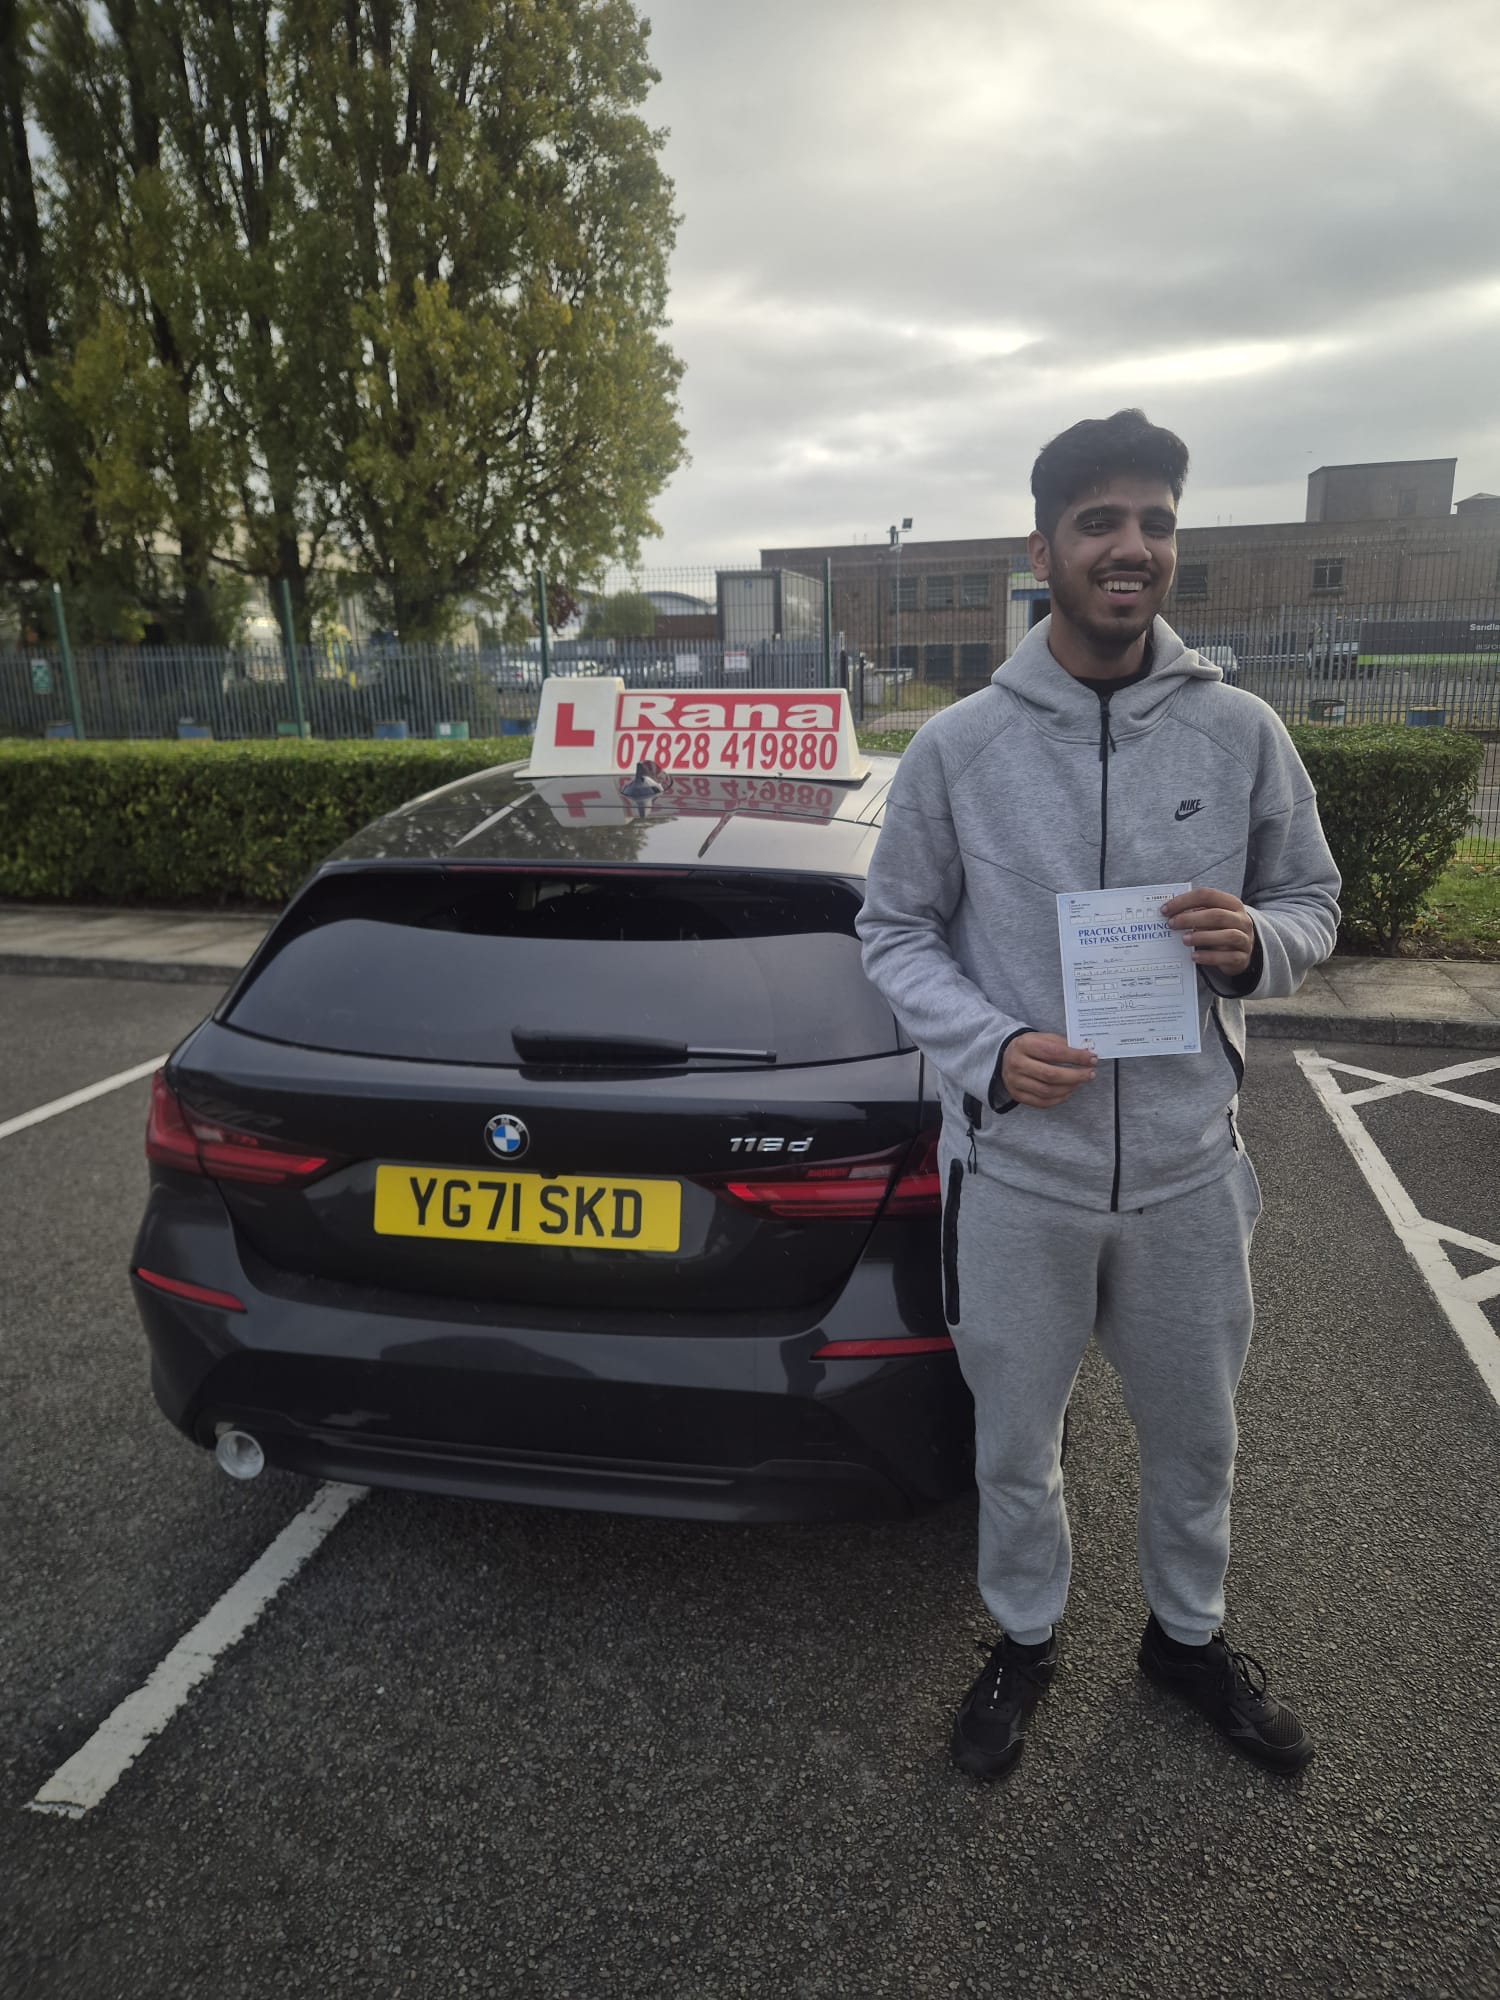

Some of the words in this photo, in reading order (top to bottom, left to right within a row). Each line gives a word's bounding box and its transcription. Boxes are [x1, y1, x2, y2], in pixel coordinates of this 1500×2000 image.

[554, 703, 595, 747] L
[620, 696, 834, 729] Rana
[616, 732, 711, 770] 07828
[720, 732, 838, 771] 419880
[1179, 799, 1202, 812] NIKE
[1078, 926, 1128, 937] PRACTICAL
[1121, 931, 1172, 942] CERTIFICATE
[409, 1176, 522, 1232] YG71
[538, 1185, 643, 1239] SKD
